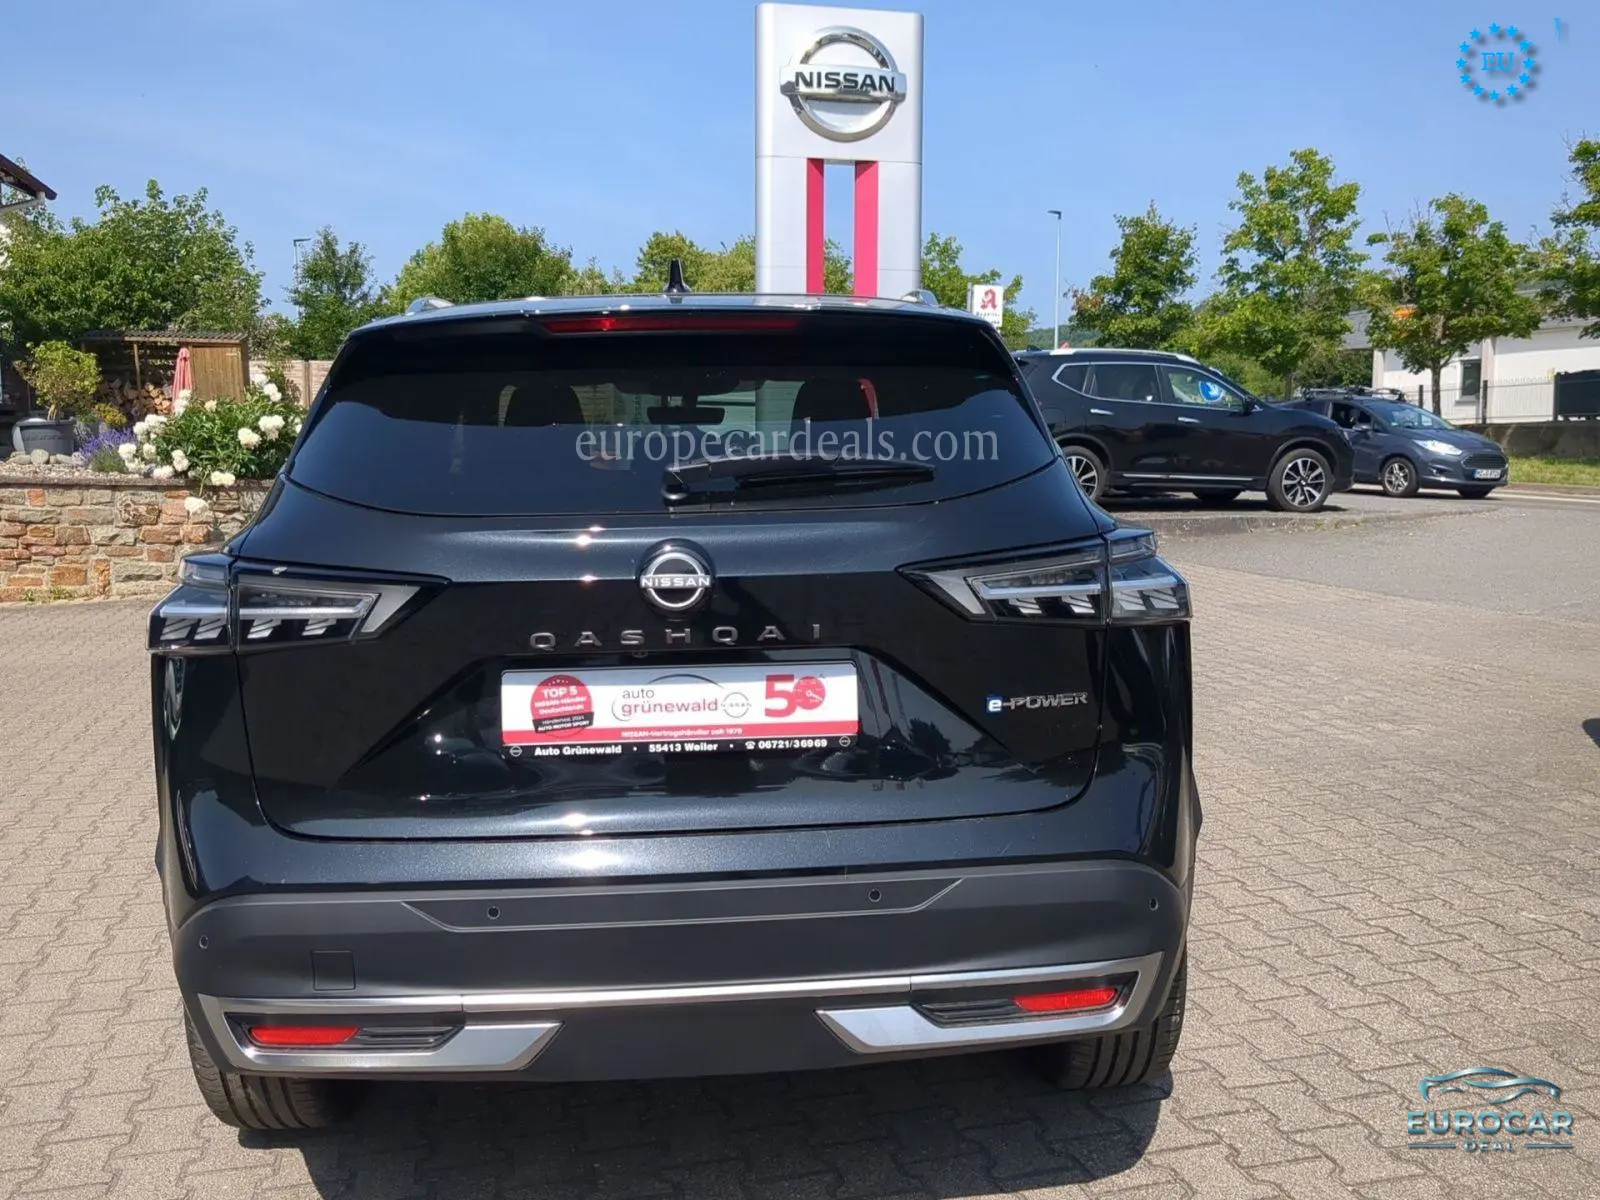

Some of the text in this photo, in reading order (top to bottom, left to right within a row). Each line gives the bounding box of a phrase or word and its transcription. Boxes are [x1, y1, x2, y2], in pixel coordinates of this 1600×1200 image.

[795, 71, 895, 92] NISSAN
[641, 575, 710, 587] NISSAN
[529, 623, 820, 650] QASHQAI
[542, 685, 578, 698] TOP 5
[622, 688, 655, 699] auto
[621, 698, 718, 717] grünewald
[988, 692, 1088, 711] e-POWER
[534, 739, 828, 756] Auto Grünewald 55413 Weiler 06721/36969
